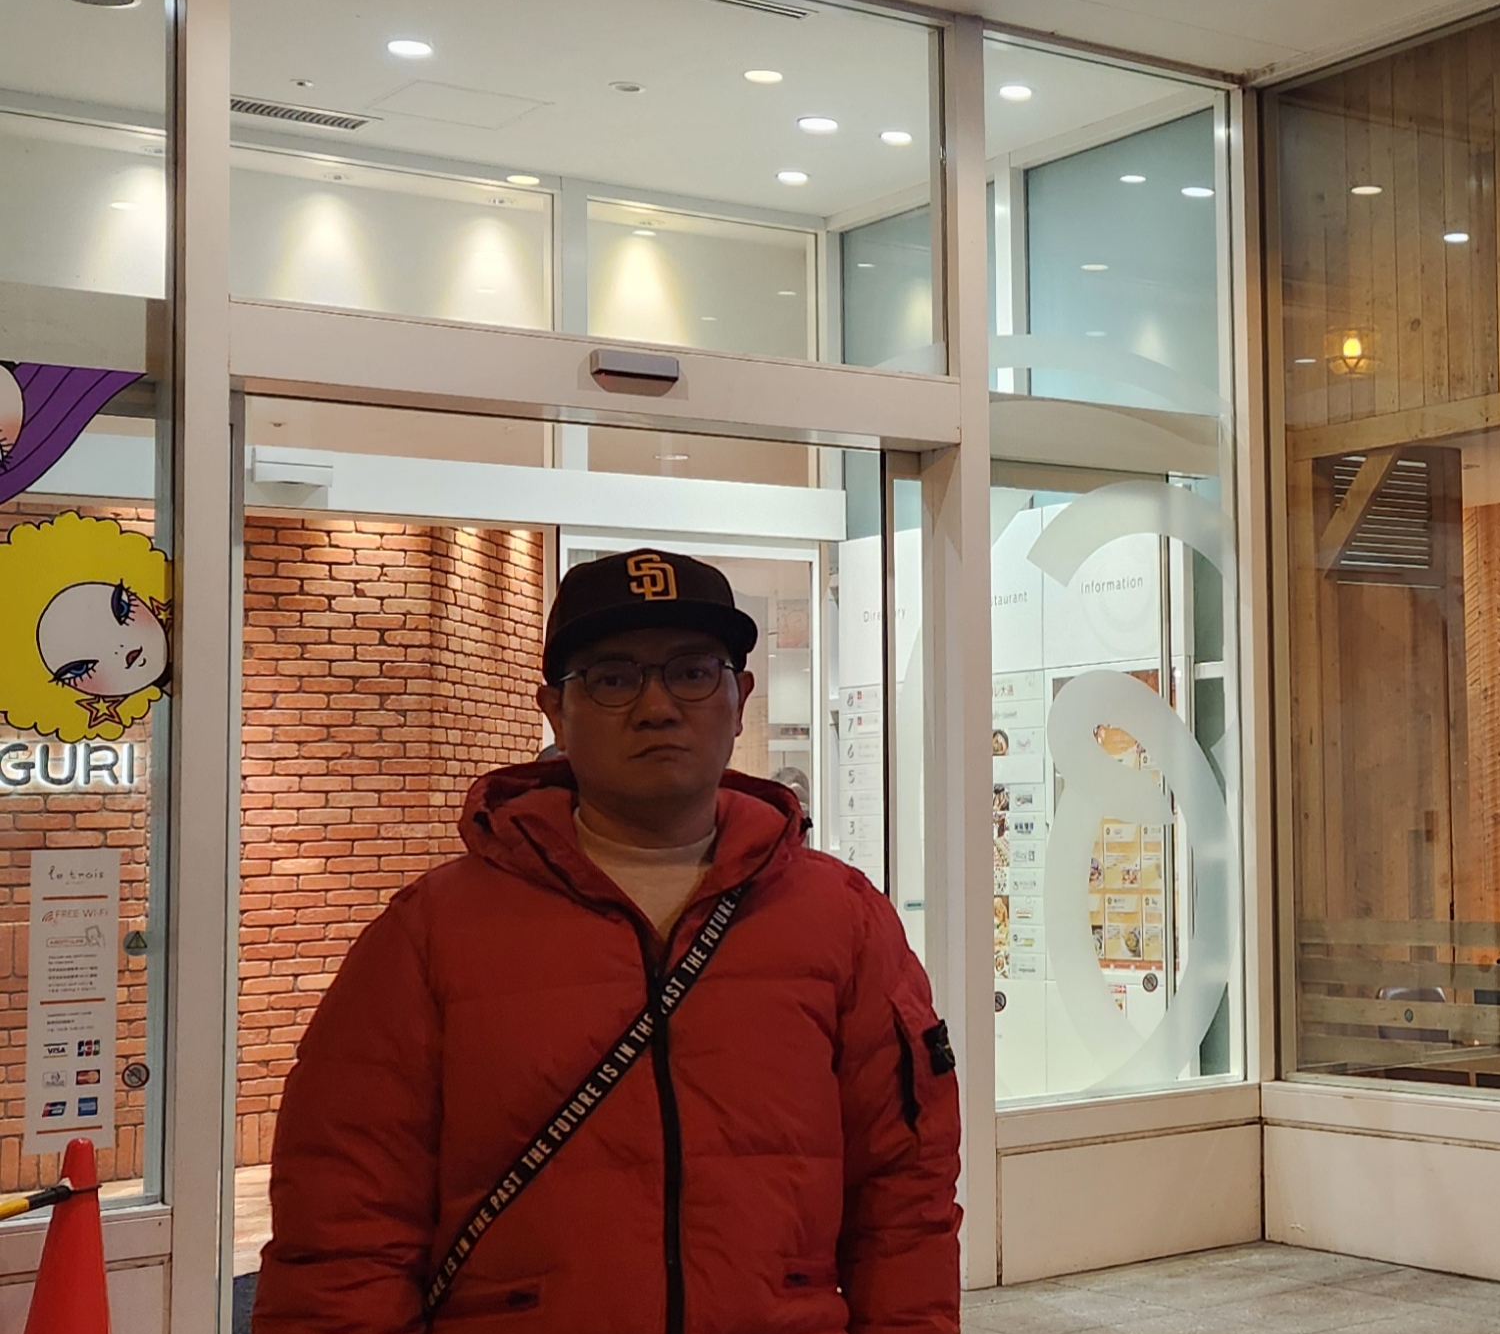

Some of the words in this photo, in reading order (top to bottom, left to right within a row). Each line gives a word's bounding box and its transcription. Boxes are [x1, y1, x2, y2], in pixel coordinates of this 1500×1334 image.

[1080, 575, 1144, 595] Information
[55, 909, 80, 919] FREE
[681, 946, 708, 975] THE
[700, 896, 736, 948] FUTURE
[47, 1046, 66, 1055] VISA
[468, 1207, 494, 1238] THE
[489, 1170, 523, 1211] PAST
[521, 1139, 552, 1170] THE
[547, 1082, 603, 1141] FUTURE
[597, 1063, 619, 1084] IS
[614, 1042, 636, 1064] IN
